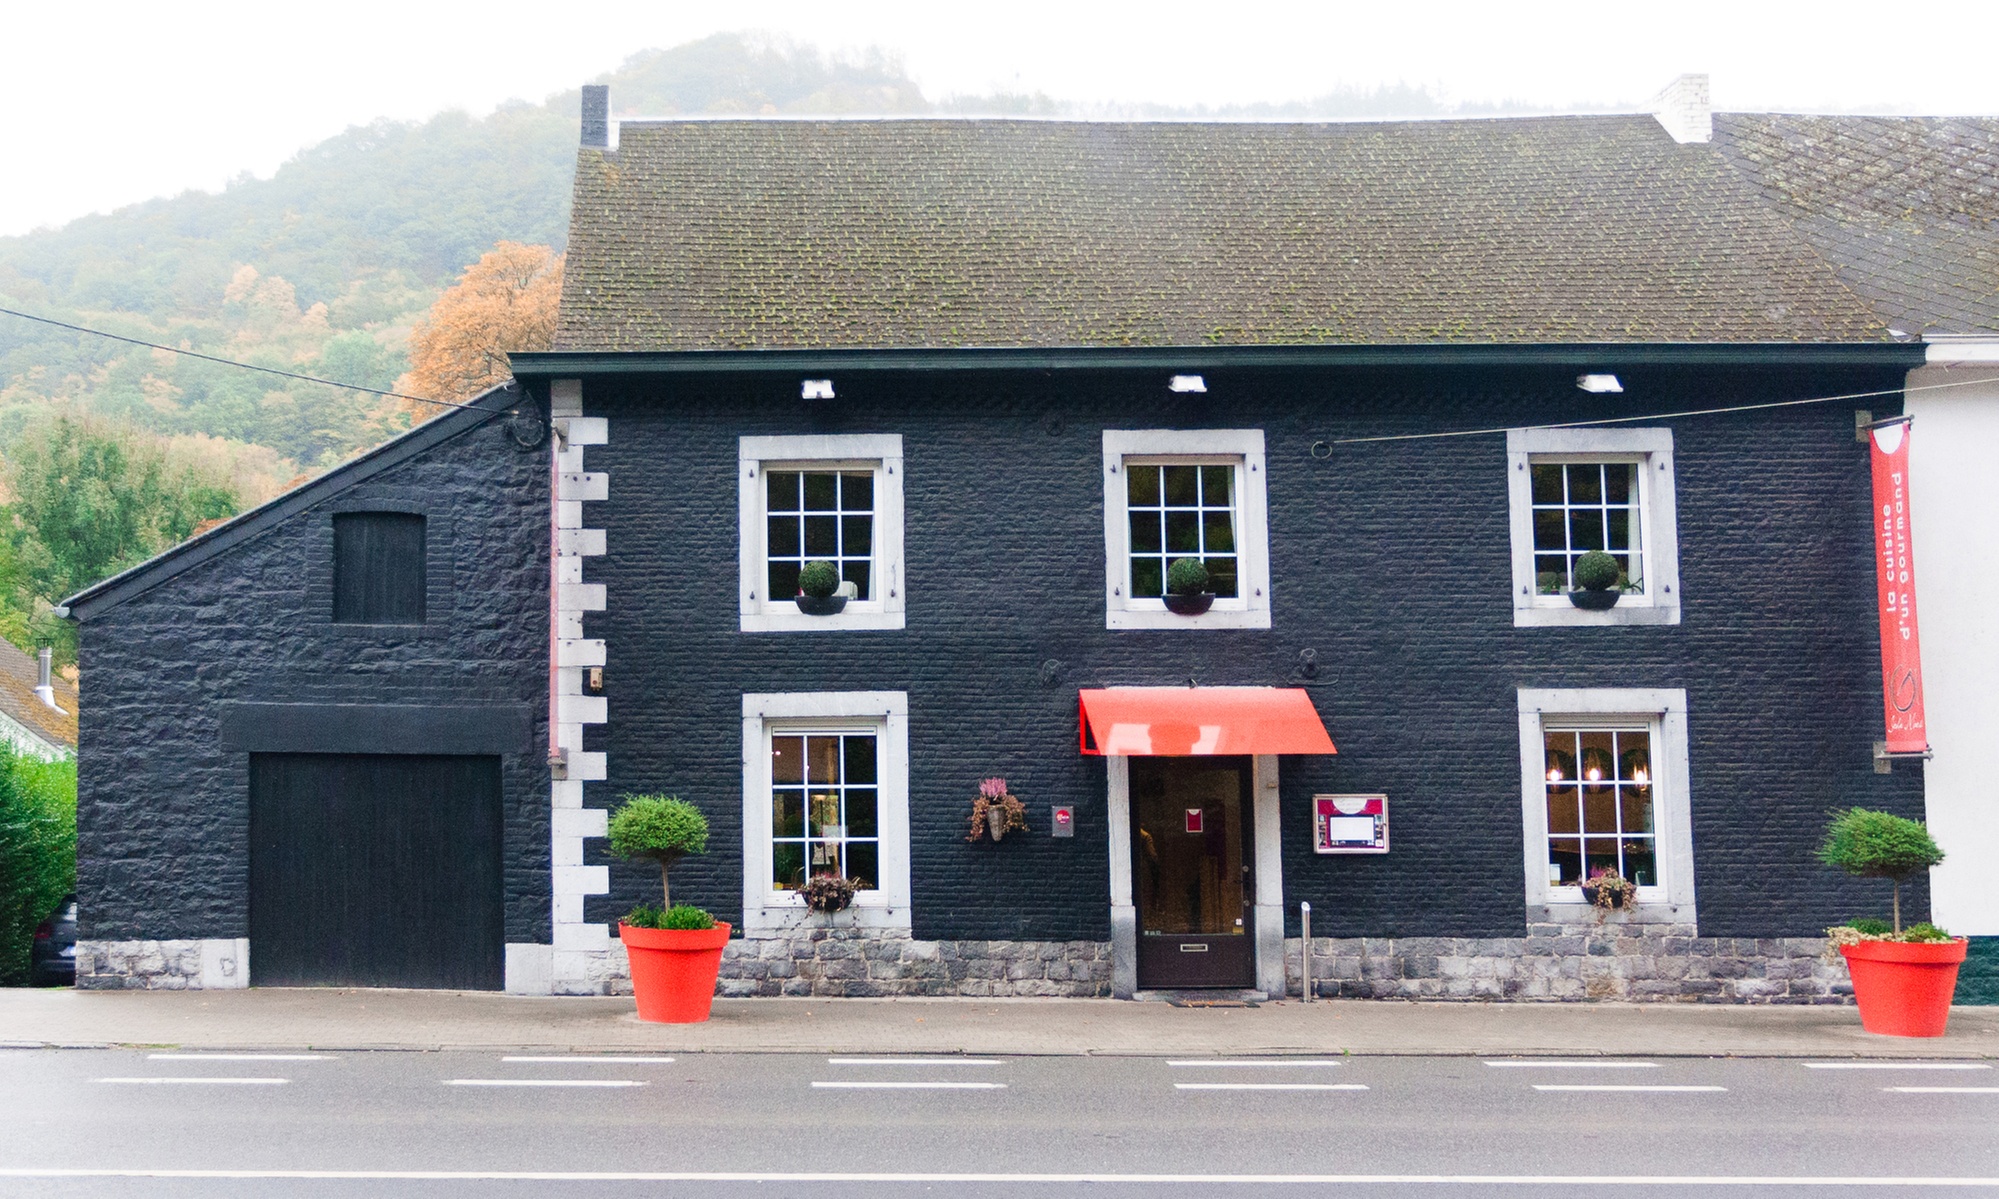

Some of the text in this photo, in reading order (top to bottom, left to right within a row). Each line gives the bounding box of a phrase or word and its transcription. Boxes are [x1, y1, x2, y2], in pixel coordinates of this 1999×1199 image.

[1882, 504, 1897, 612] la cuisine
[1891, 472, 1910, 640] d'un gourmand
